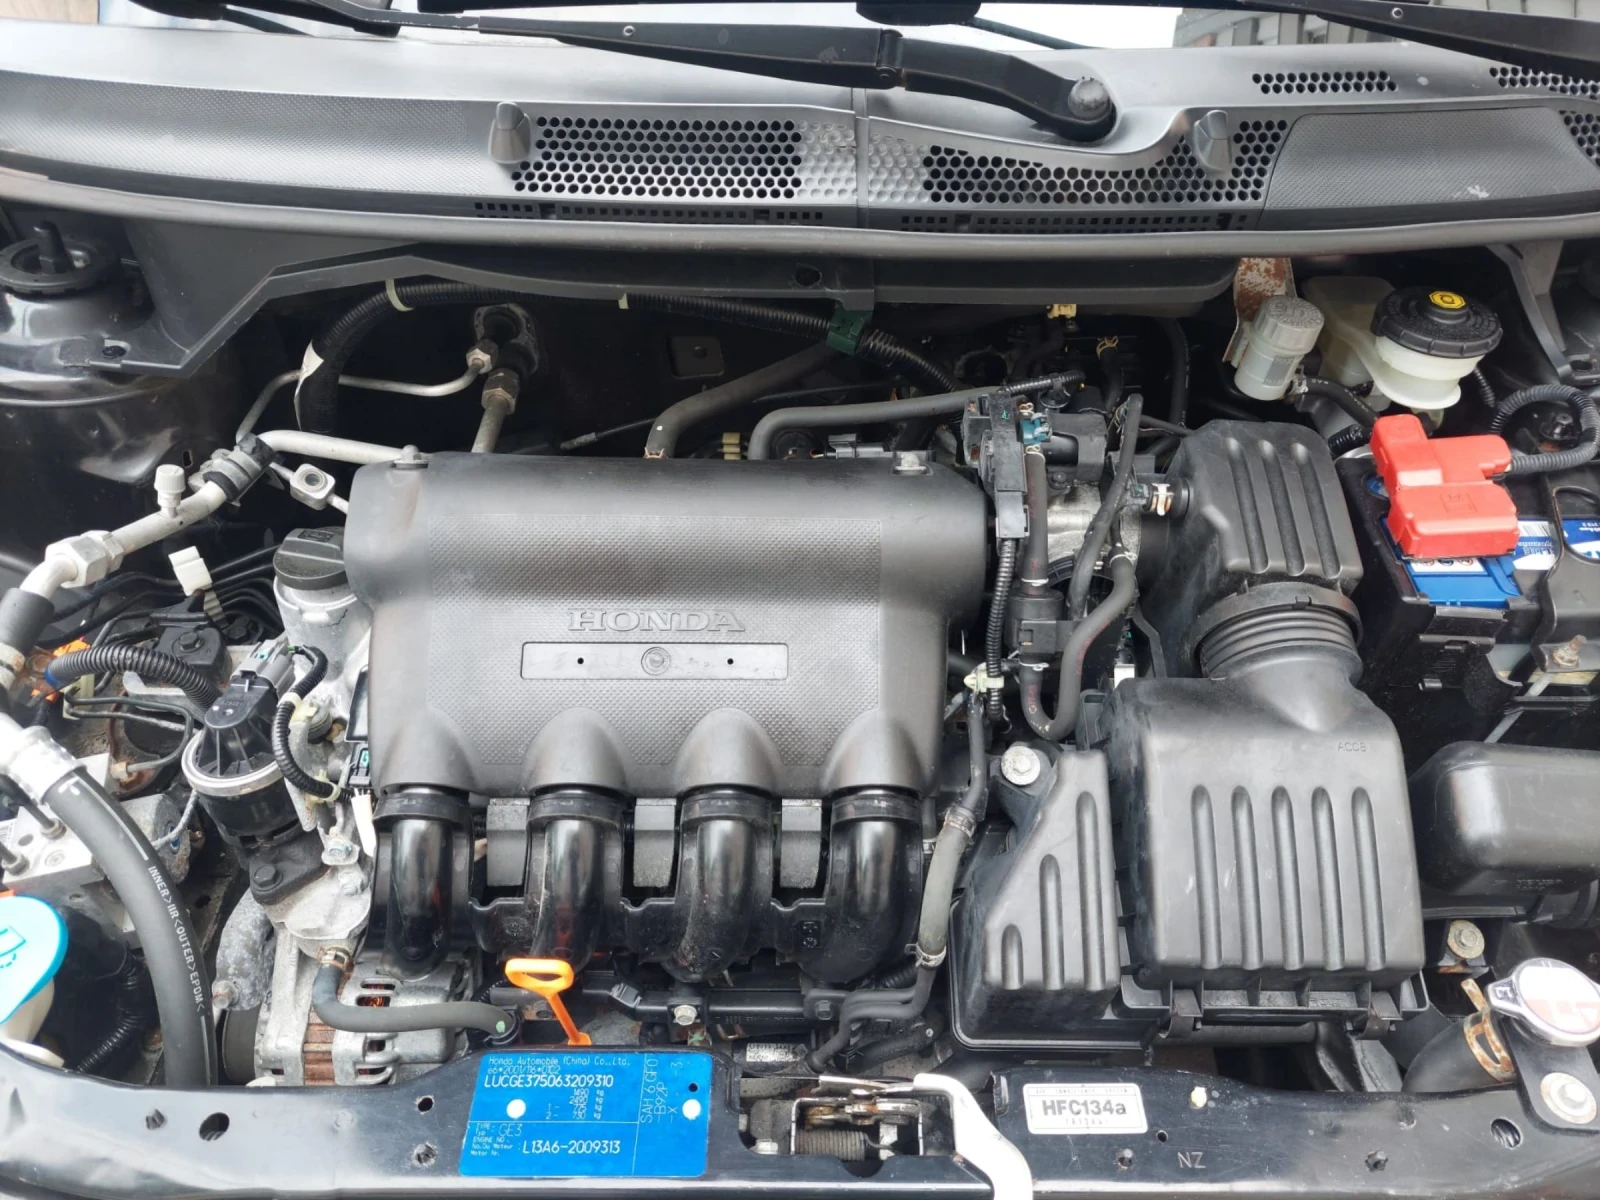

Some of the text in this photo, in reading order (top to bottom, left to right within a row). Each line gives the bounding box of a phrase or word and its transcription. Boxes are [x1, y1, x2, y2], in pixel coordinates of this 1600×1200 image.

[567, 608, 746, 633] HONDA
[517, 1056, 559, 1065] Automobile
[563, 1056, 590, 1066] (China)
[483, 1074, 614, 1088] LUCGE375063209310
[640, 1098, 654, 1124] SAH
[1041, 1098, 1128, 1117] HFC134a
[499, 1123, 523, 1137] GE3
[522, 1140, 621, 1154] L13A6-2009313
[1177, 1151, 1206, 1169] NZ
